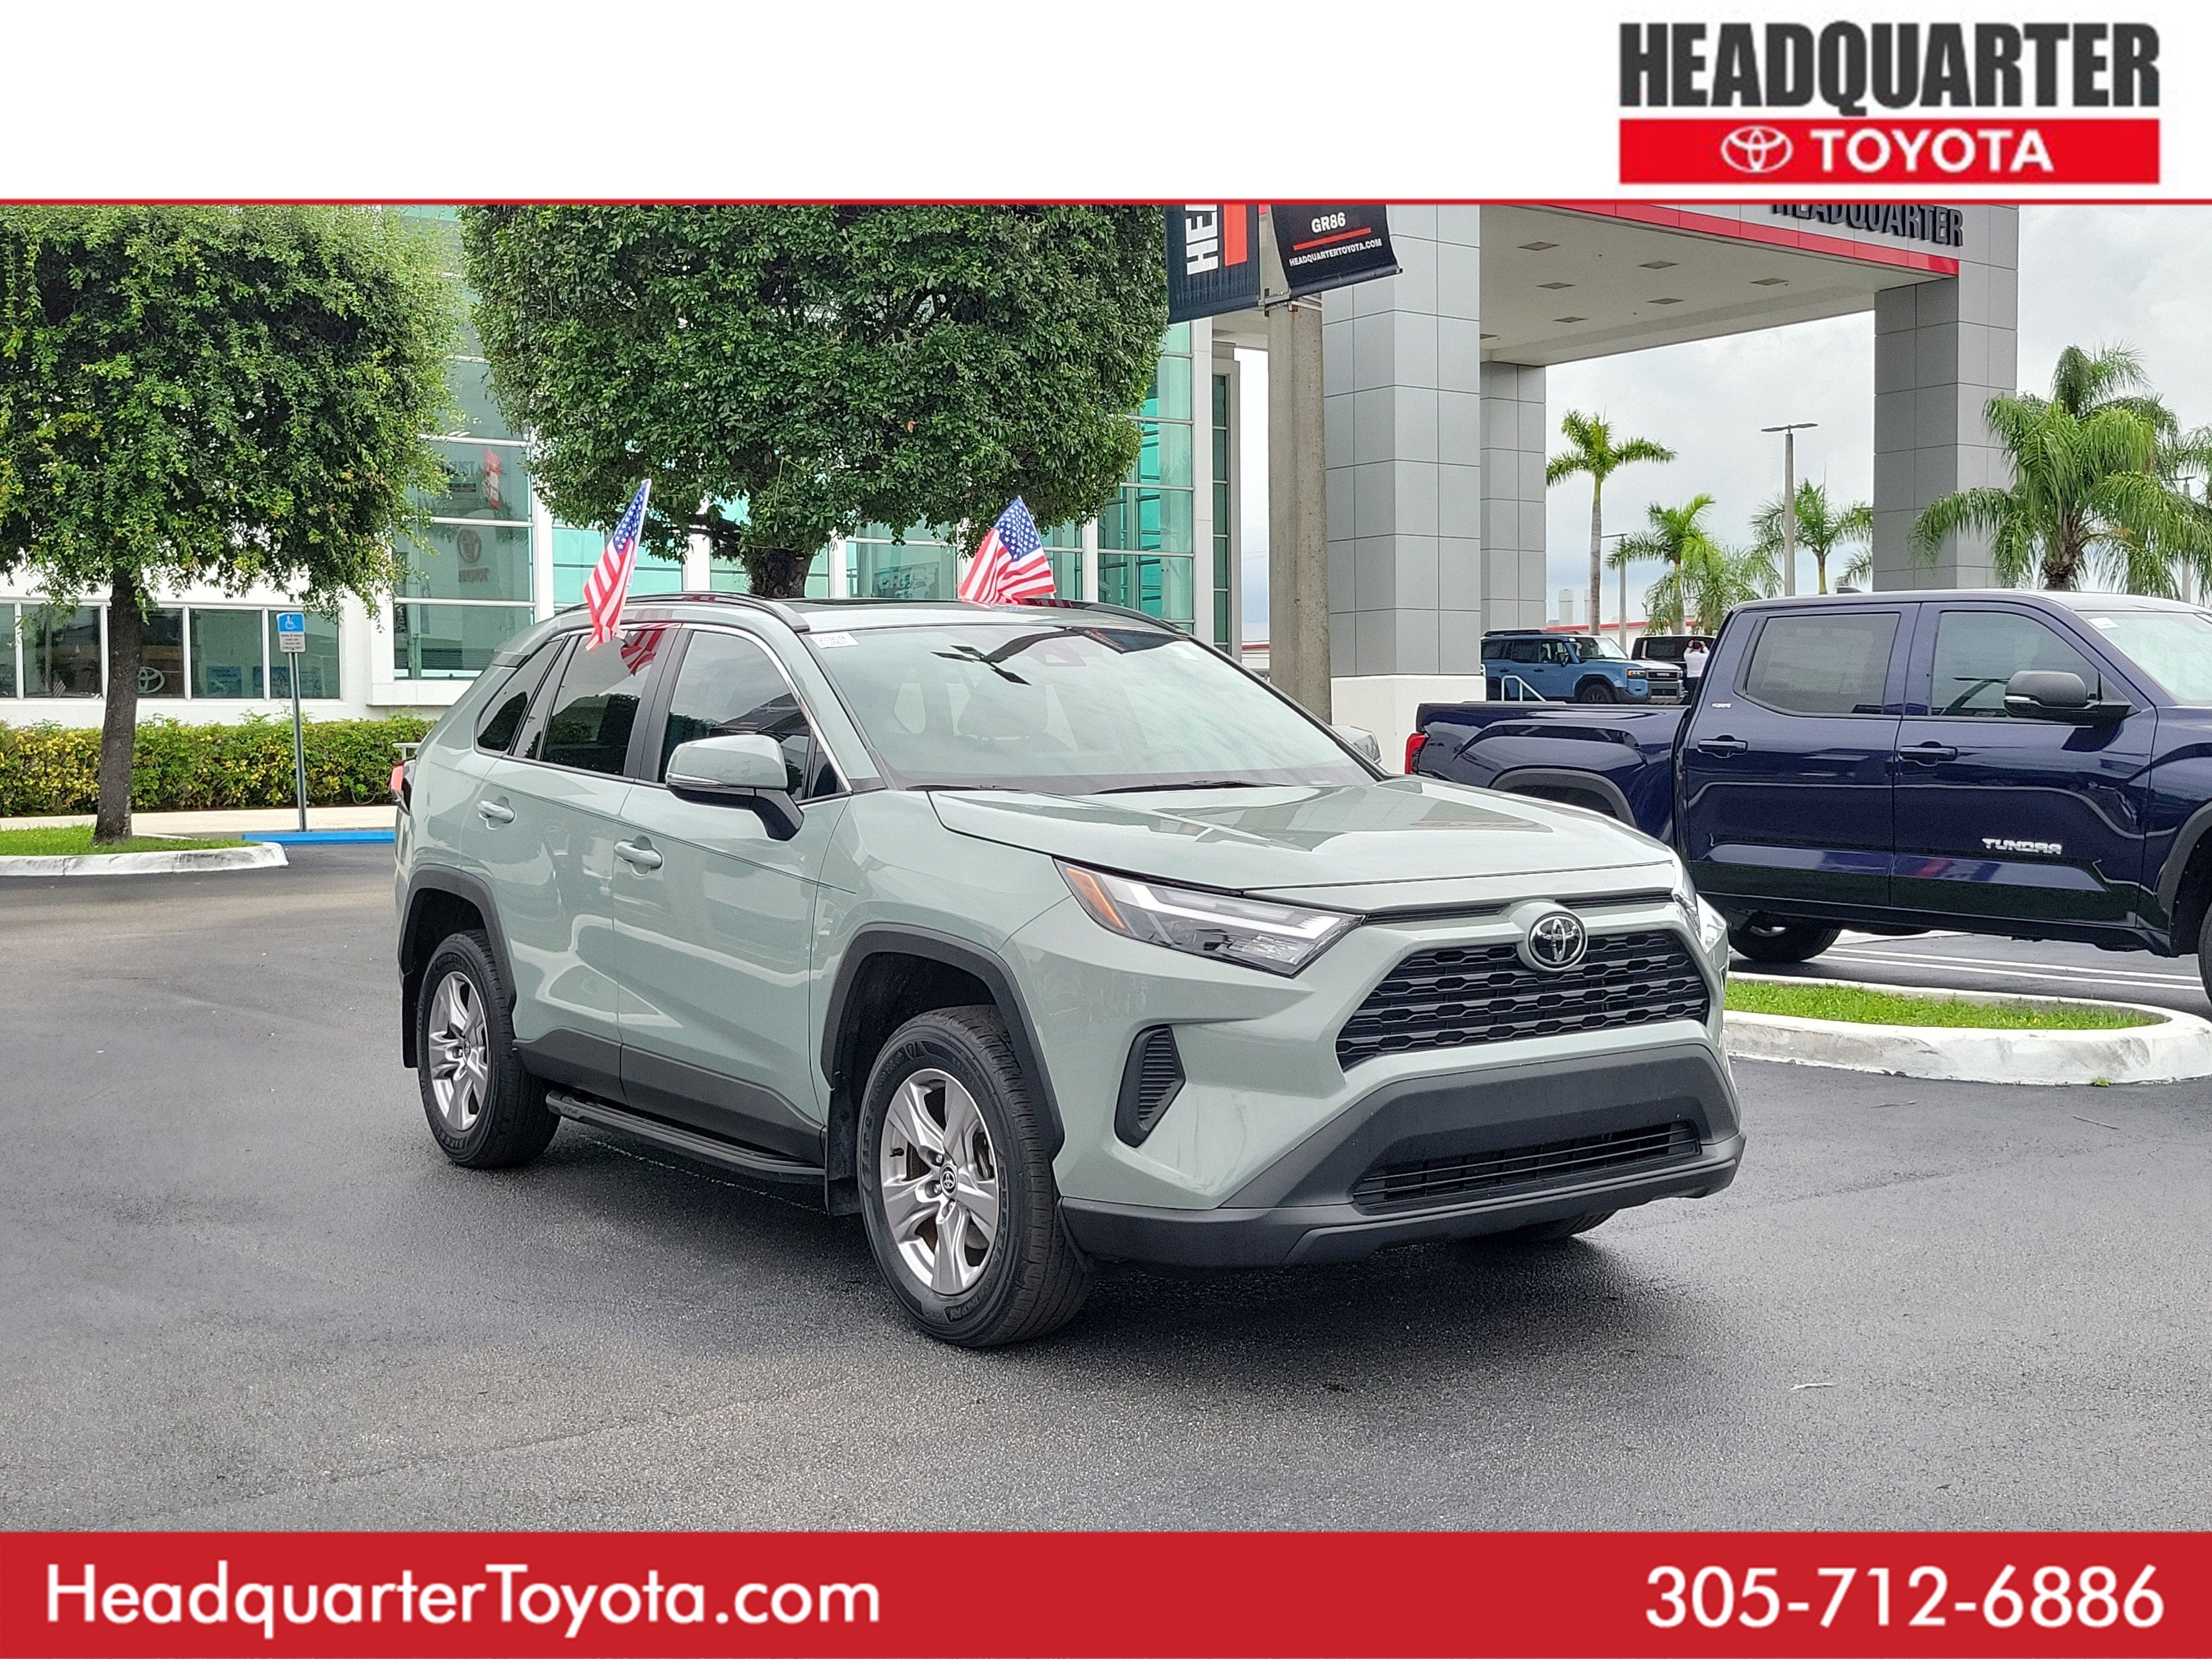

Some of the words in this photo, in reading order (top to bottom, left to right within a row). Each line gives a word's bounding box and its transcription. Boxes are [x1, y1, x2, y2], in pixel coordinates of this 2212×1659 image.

[1311, 212, 1346, 233] GR86
[1185, 204, 1218, 275] HE
[1289, 238, 1382, 267] HEADQUARTERTOYOTA.COM
[1981, 838, 2062, 855] TUNDRA
